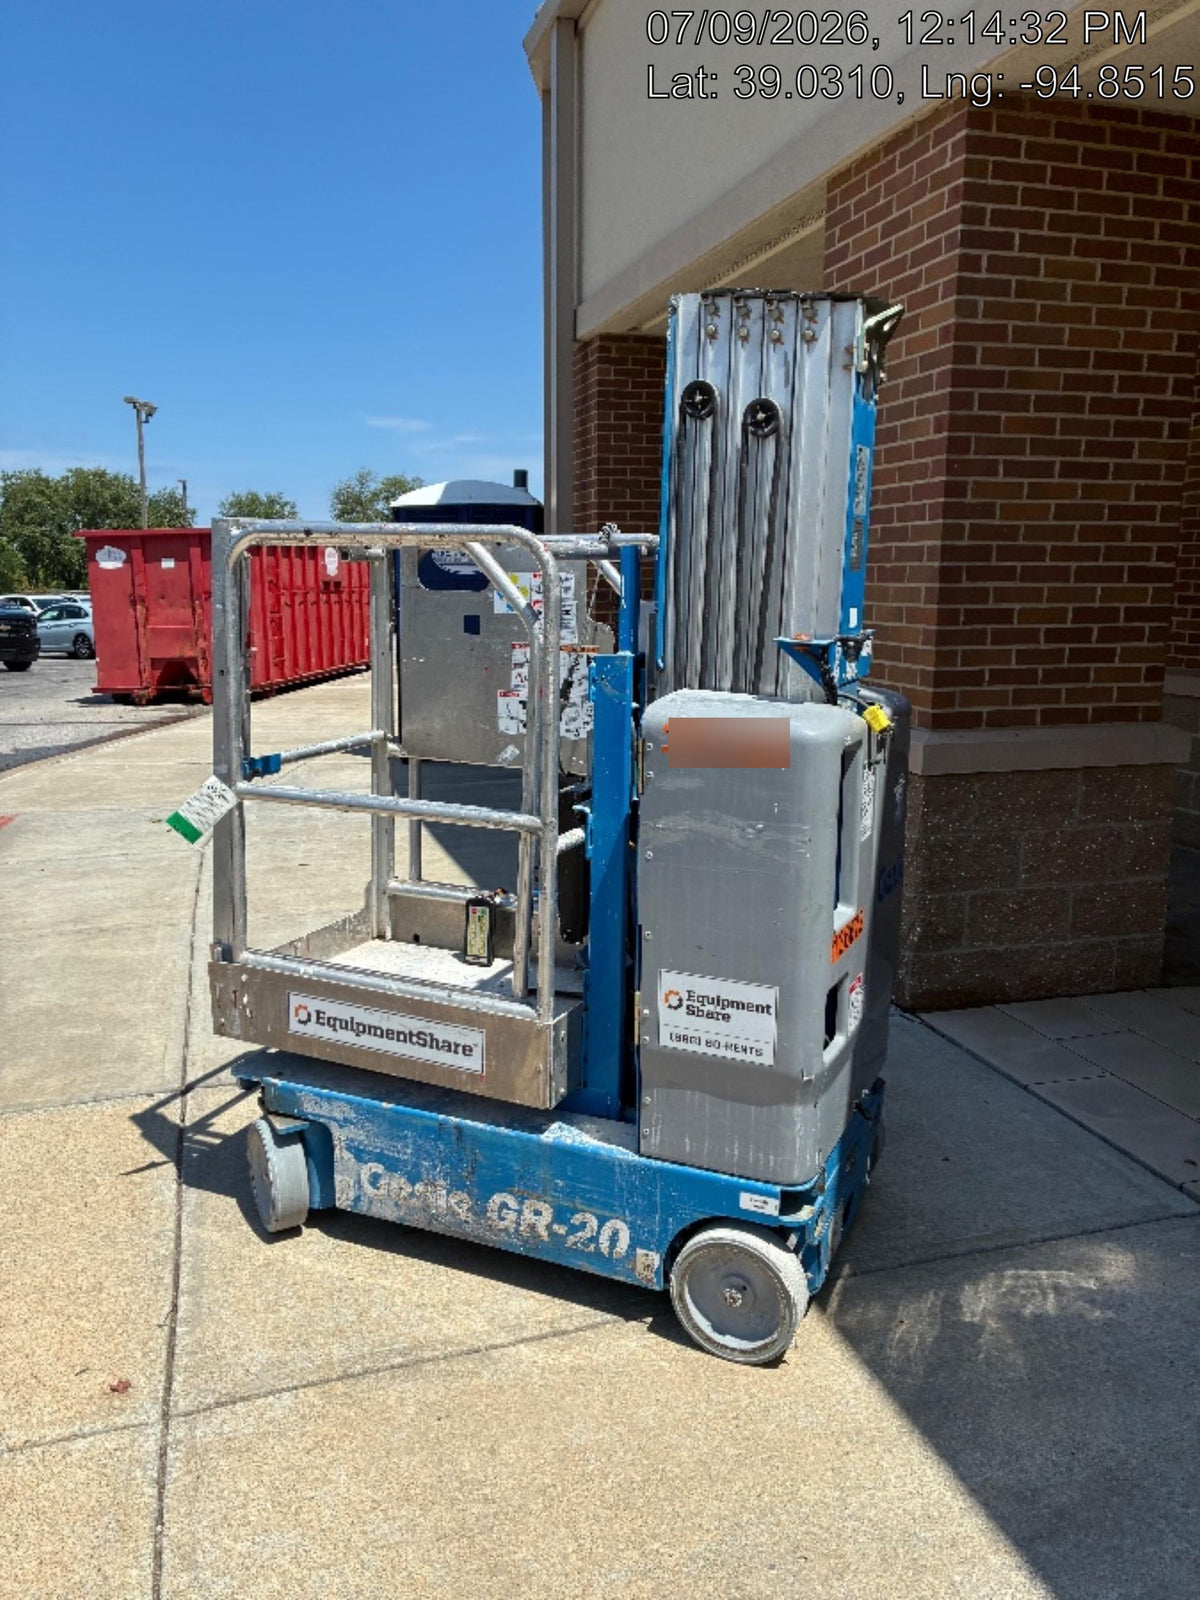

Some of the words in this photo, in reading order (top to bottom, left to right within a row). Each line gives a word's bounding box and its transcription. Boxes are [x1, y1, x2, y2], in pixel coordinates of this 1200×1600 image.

[685, 989, 773, 1016] Equipment
[685, 1003, 732, 1023] Share
[314, 1009, 474, 1058] EquipmentShare
[486, 1191, 630, 1259] GR-20
